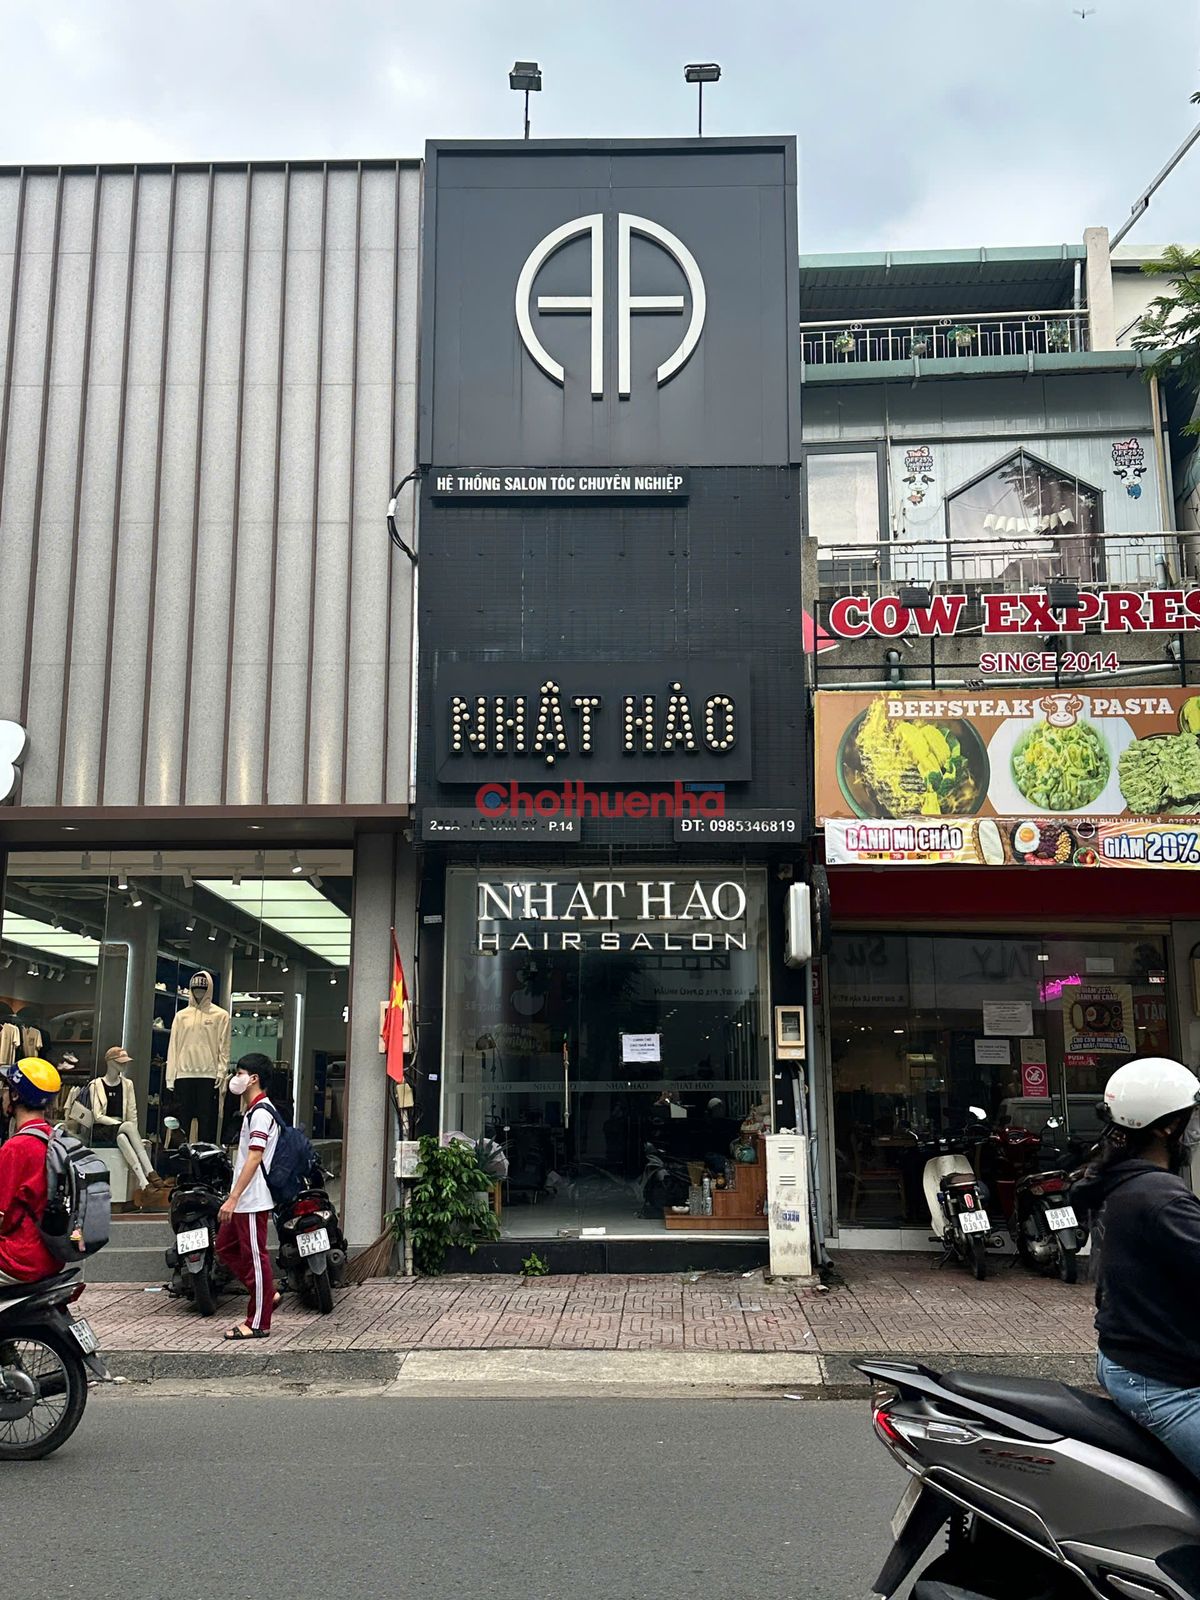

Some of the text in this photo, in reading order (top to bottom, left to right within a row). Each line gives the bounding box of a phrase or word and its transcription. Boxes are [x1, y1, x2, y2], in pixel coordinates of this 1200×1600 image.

[437, 472, 683, 494] HỆ THỐNG SALON TÓC CHUYÊN NGHIỆP
[829, 594, 968, 638] COW
[979, 650, 1120, 674] SINCE 2014
[887, 698, 1175, 717] BEEFSTEAK PASTA
[450, 680, 602, 769] NHẬT
[548, 820, 574, 832] P.14
[680, 819, 796, 832] ĐT: 0985346819
[846, 824, 963, 851] BÁNH MÌ CHẢO
[1103, 832, 1199, 862] GIẢM 20%
[478, 880, 747, 921] NHAT HAO
